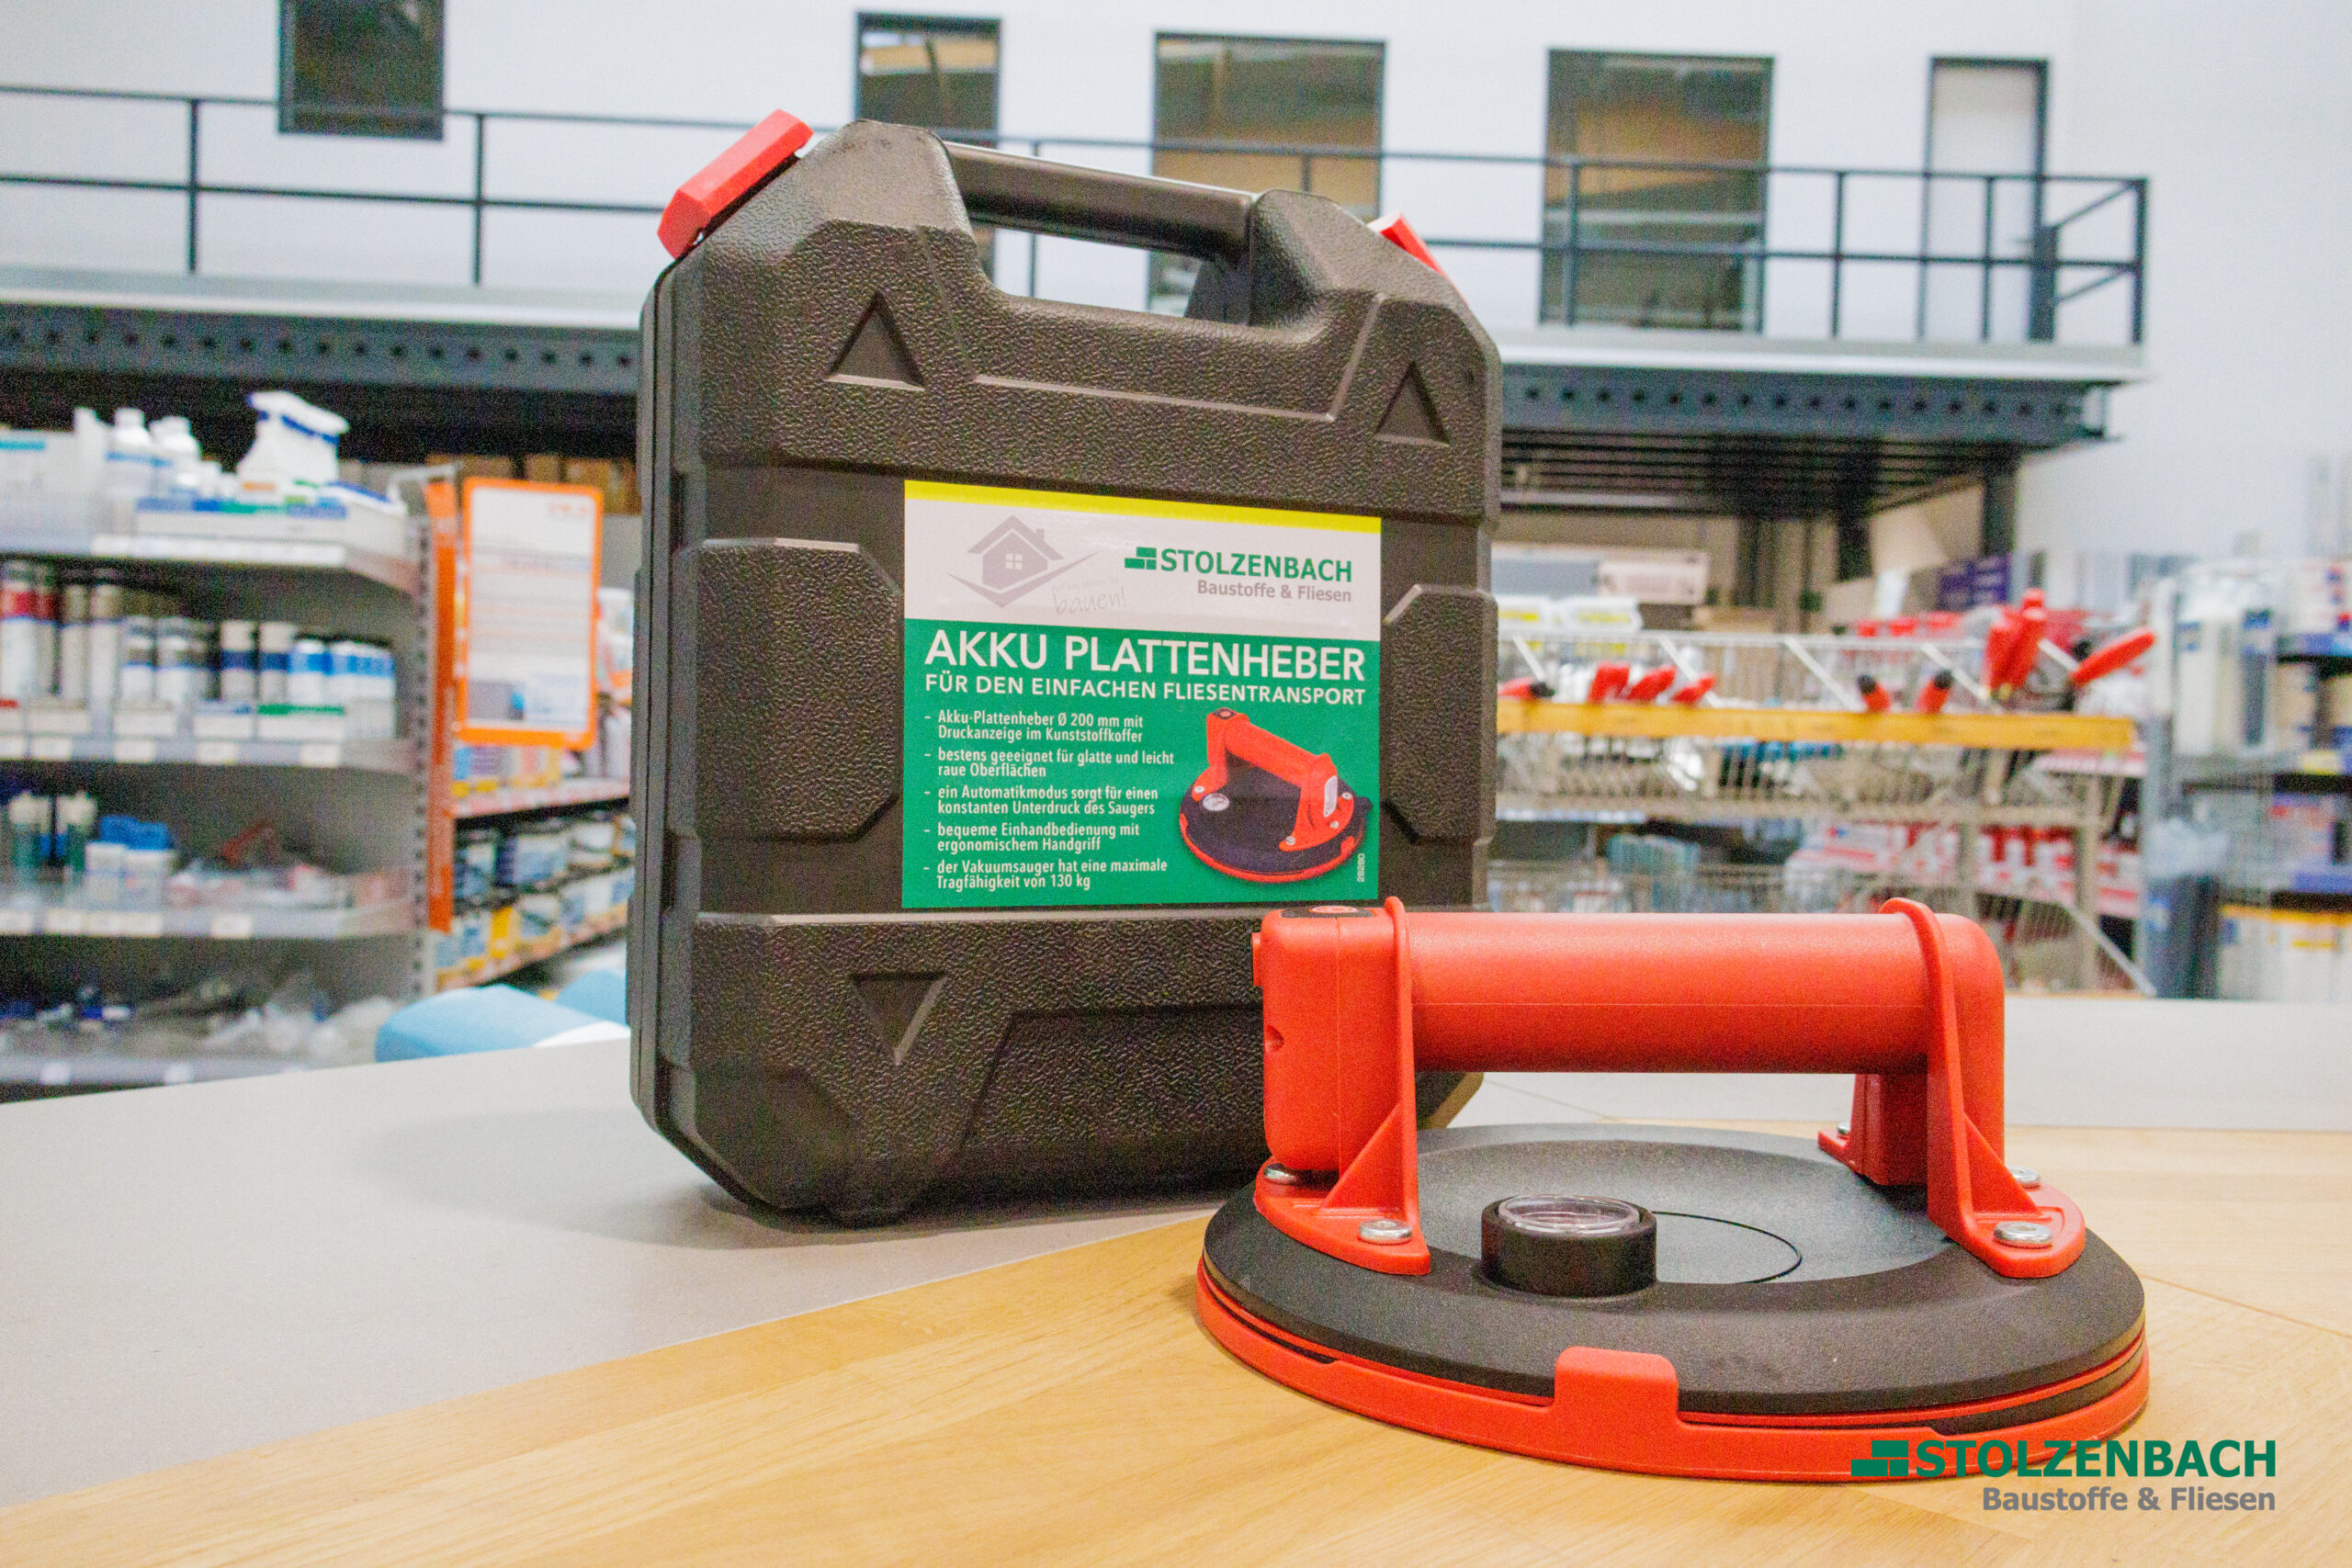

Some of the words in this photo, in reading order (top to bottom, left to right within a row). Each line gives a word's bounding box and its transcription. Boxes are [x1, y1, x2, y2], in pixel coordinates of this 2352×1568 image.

[1160, 548, 1352, 582] STOLZENBACH
[1198, 580, 1275, 598] Baustoffe
[1281, 584, 1292, 599] &
[1298, 585, 1351, 602] Fliesen
[1051, 587, 1126, 615] bauen!
[924, 629, 1047, 670] AKKU
[1066, 635, 1365, 682] PLATTENHEBER
[925, 671, 967, 693] FÜR
[976, 676, 1023, 694] DEN
[1032, 677, 1156, 698] EINFACHEN
[1163, 682, 1365, 705] FLIESENTRANSPORT
[938, 709, 1055, 727] Akku-Plattenheber
[1070, 714, 1093, 727] 200
[1098, 716, 1119, 728] mm
[1124, 716, 1143, 728] mit
[938, 725, 1023, 743] Druckanzeige
[1026, 728, 1041, 740] im
[1046, 728, 1143, 742] Kunststoffkoffer
[938, 747, 987, 761] bestens
[990, 750, 1053, 765] geeeignet
[1057, 749, 1074, 762] für
[1078, 750, 1112, 766] glatte
[1116, 750, 1138, 763] und
[1142, 750, 1174, 764] leicht
[938, 765, 966, 776] raue
[970, 762, 1046, 777] Oberflächen
[938, 786, 958, 798] ein
[961, 785, 1068, 799] Automatikmodus
[1071, 787, 1102, 802] sorgt
[1105, 787, 1122, 799] für
[1125, 788, 1159, 799] einen
[938, 799, 1008, 814] konstanten
[1012, 800, 1080, 814] Unterdruck
[1084, 800, 1104, 814] des
[1108, 801, 1155, 818] Saugers
[937, 822, 998, 840] bequeme
[1001, 822, 1115, 839] Einhandbedienung
[1120, 823, 1140, 835] mit
[937, 837, 1038, 854] ergonomischem
[1043, 836, 1102, 854] Handgriff
[937, 860, 958, 874] der
[962, 860, 1055, 875] Vakuumsauger
[1058, 858, 1078, 873] hat
[1081, 860, 1107, 872] eine
[1111, 858, 1168, 872] maximale
[936, 874, 1021, 892] Tragfähigkeit
[1023, 877, 1046, 887] von
[1050, 874, 1072, 887] 130
[1076, 874, 1091, 890] kg
